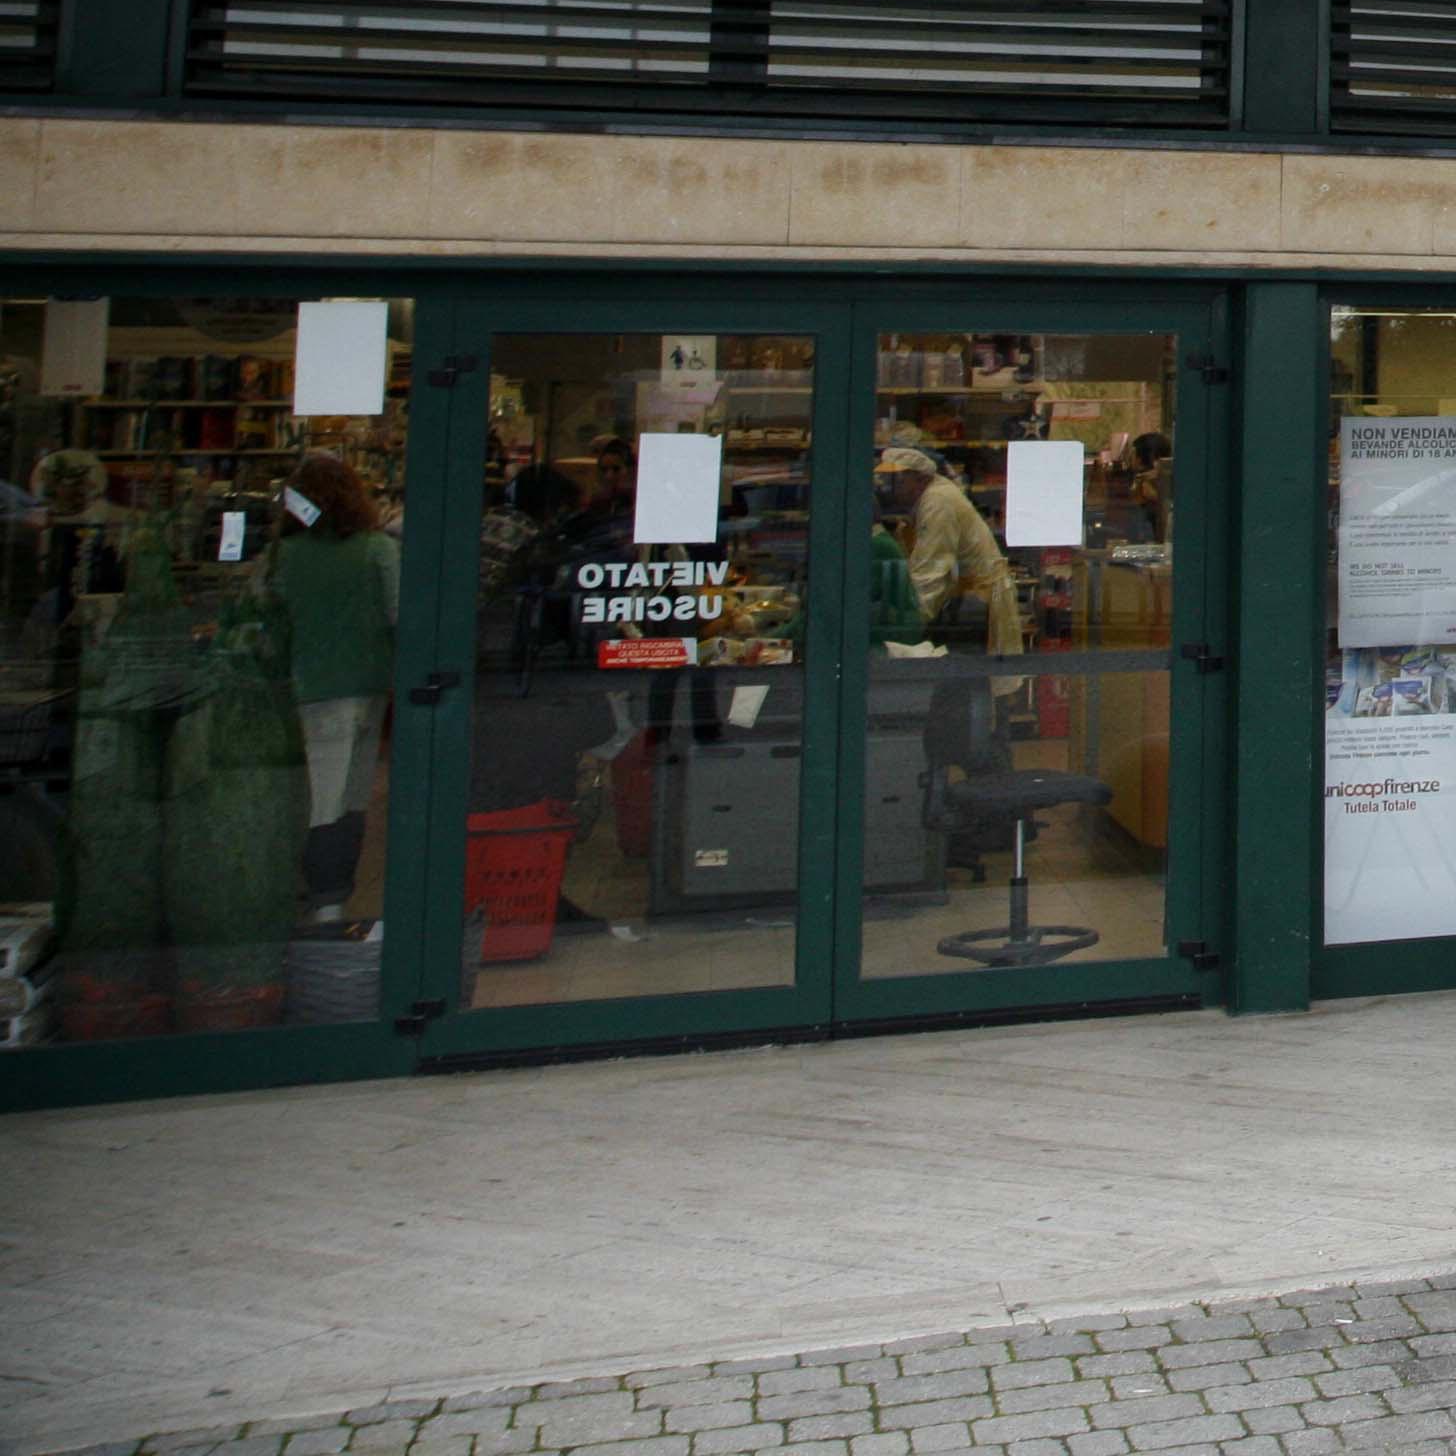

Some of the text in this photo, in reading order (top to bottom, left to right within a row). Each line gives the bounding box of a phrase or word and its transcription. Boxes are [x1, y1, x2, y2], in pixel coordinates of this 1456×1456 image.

[1351, 428, 1386, 441] NON
[1351, 439, 1405, 450] BEVANDE
[1351, 450, 1362, 459] AI
[1366, 449, 1409, 458] MINORI
[1413, 448, 1425, 458] DI
[1428, 448, 1441, 458] 18
[1343, 799, 1417, 814] Tutela Totale
